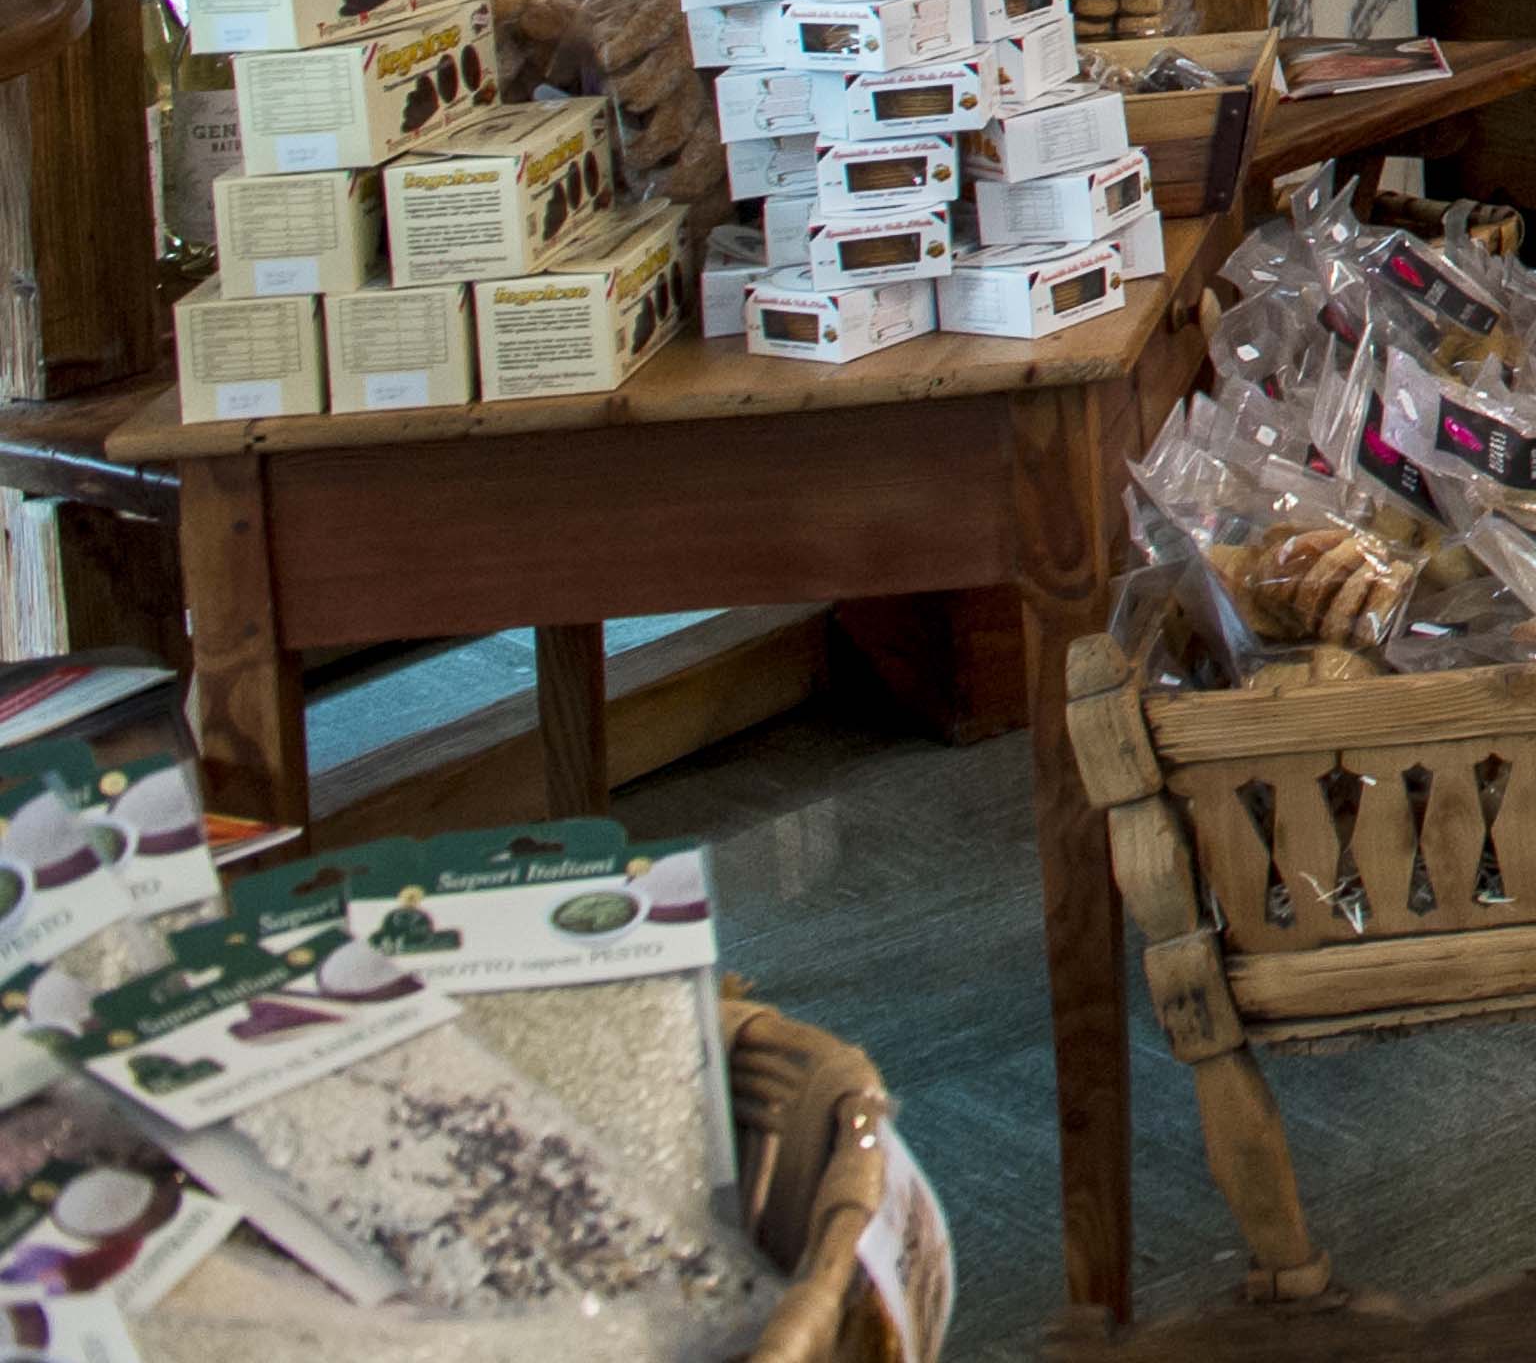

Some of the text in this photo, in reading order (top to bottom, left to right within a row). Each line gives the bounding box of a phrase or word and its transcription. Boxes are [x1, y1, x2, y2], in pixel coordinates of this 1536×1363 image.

[193, 123, 237, 140] GEN
[435, 856, 616, 893] Sapori Italiani
